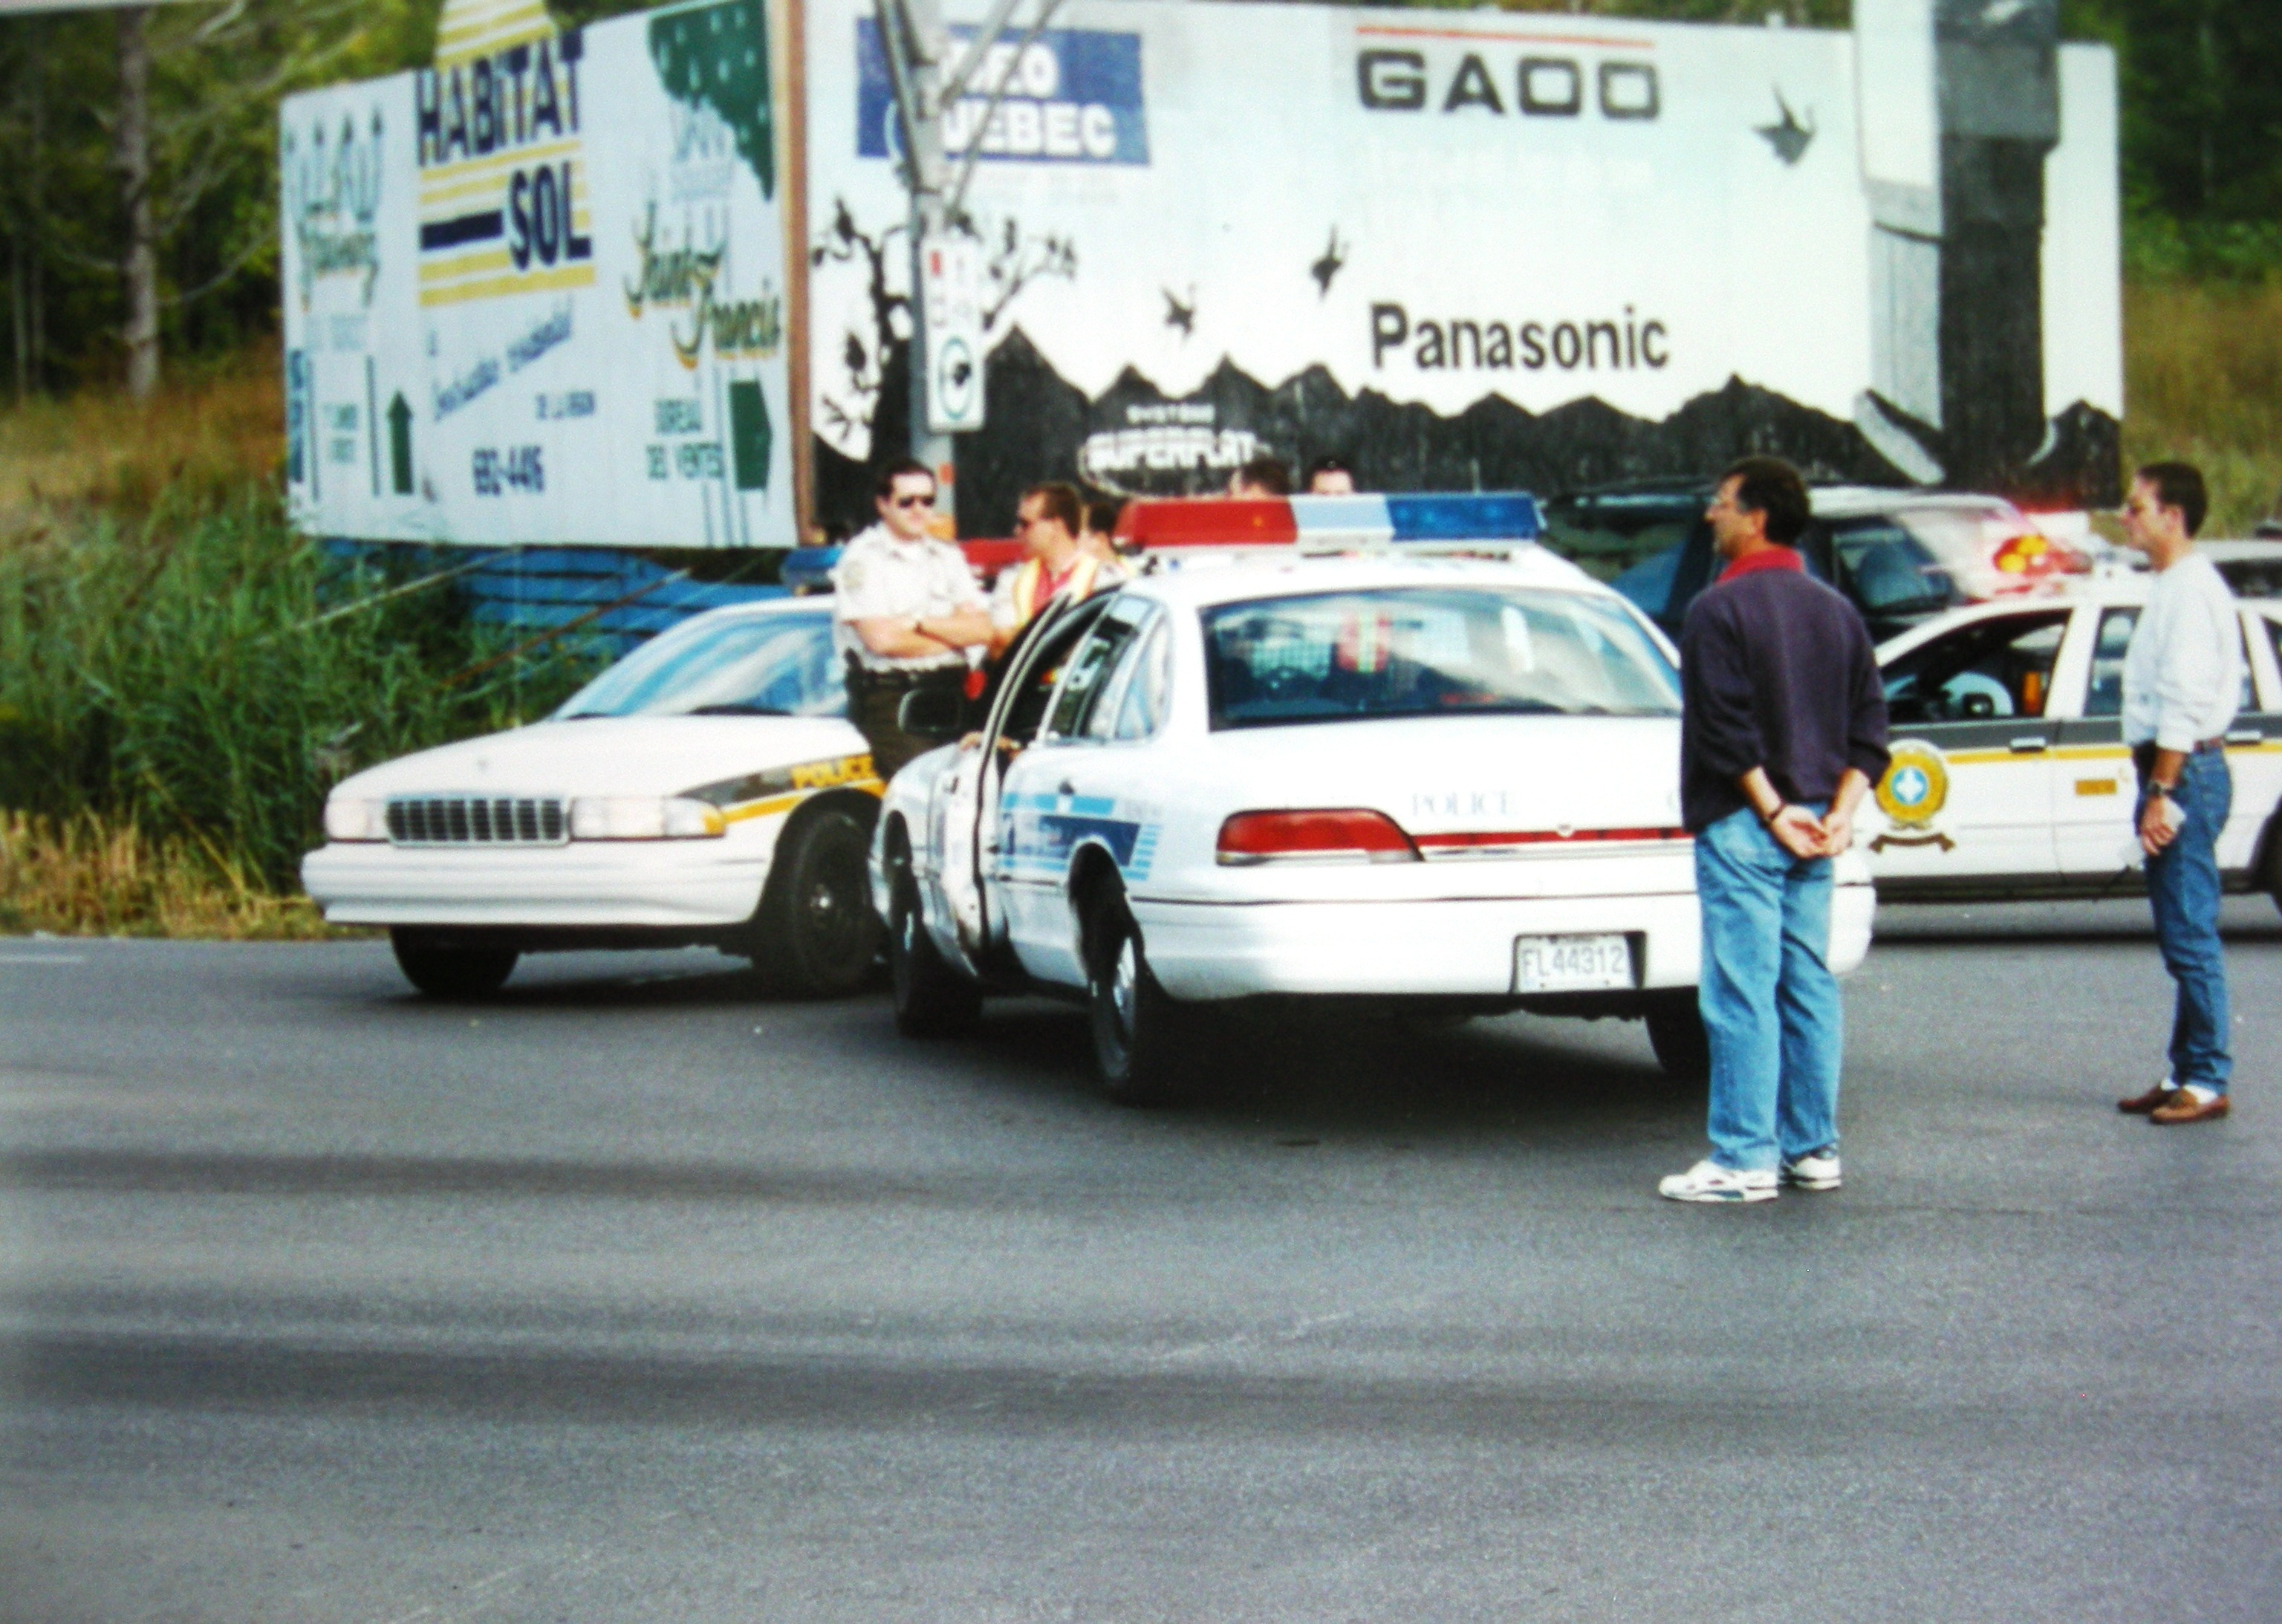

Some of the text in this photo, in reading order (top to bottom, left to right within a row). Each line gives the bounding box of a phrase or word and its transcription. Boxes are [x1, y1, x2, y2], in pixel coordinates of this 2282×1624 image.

[510, 161, 592, 272] SOL
[1369, 302, 1670, 372] Panasonic
[1521, 943, 1625, 979] FL44312
